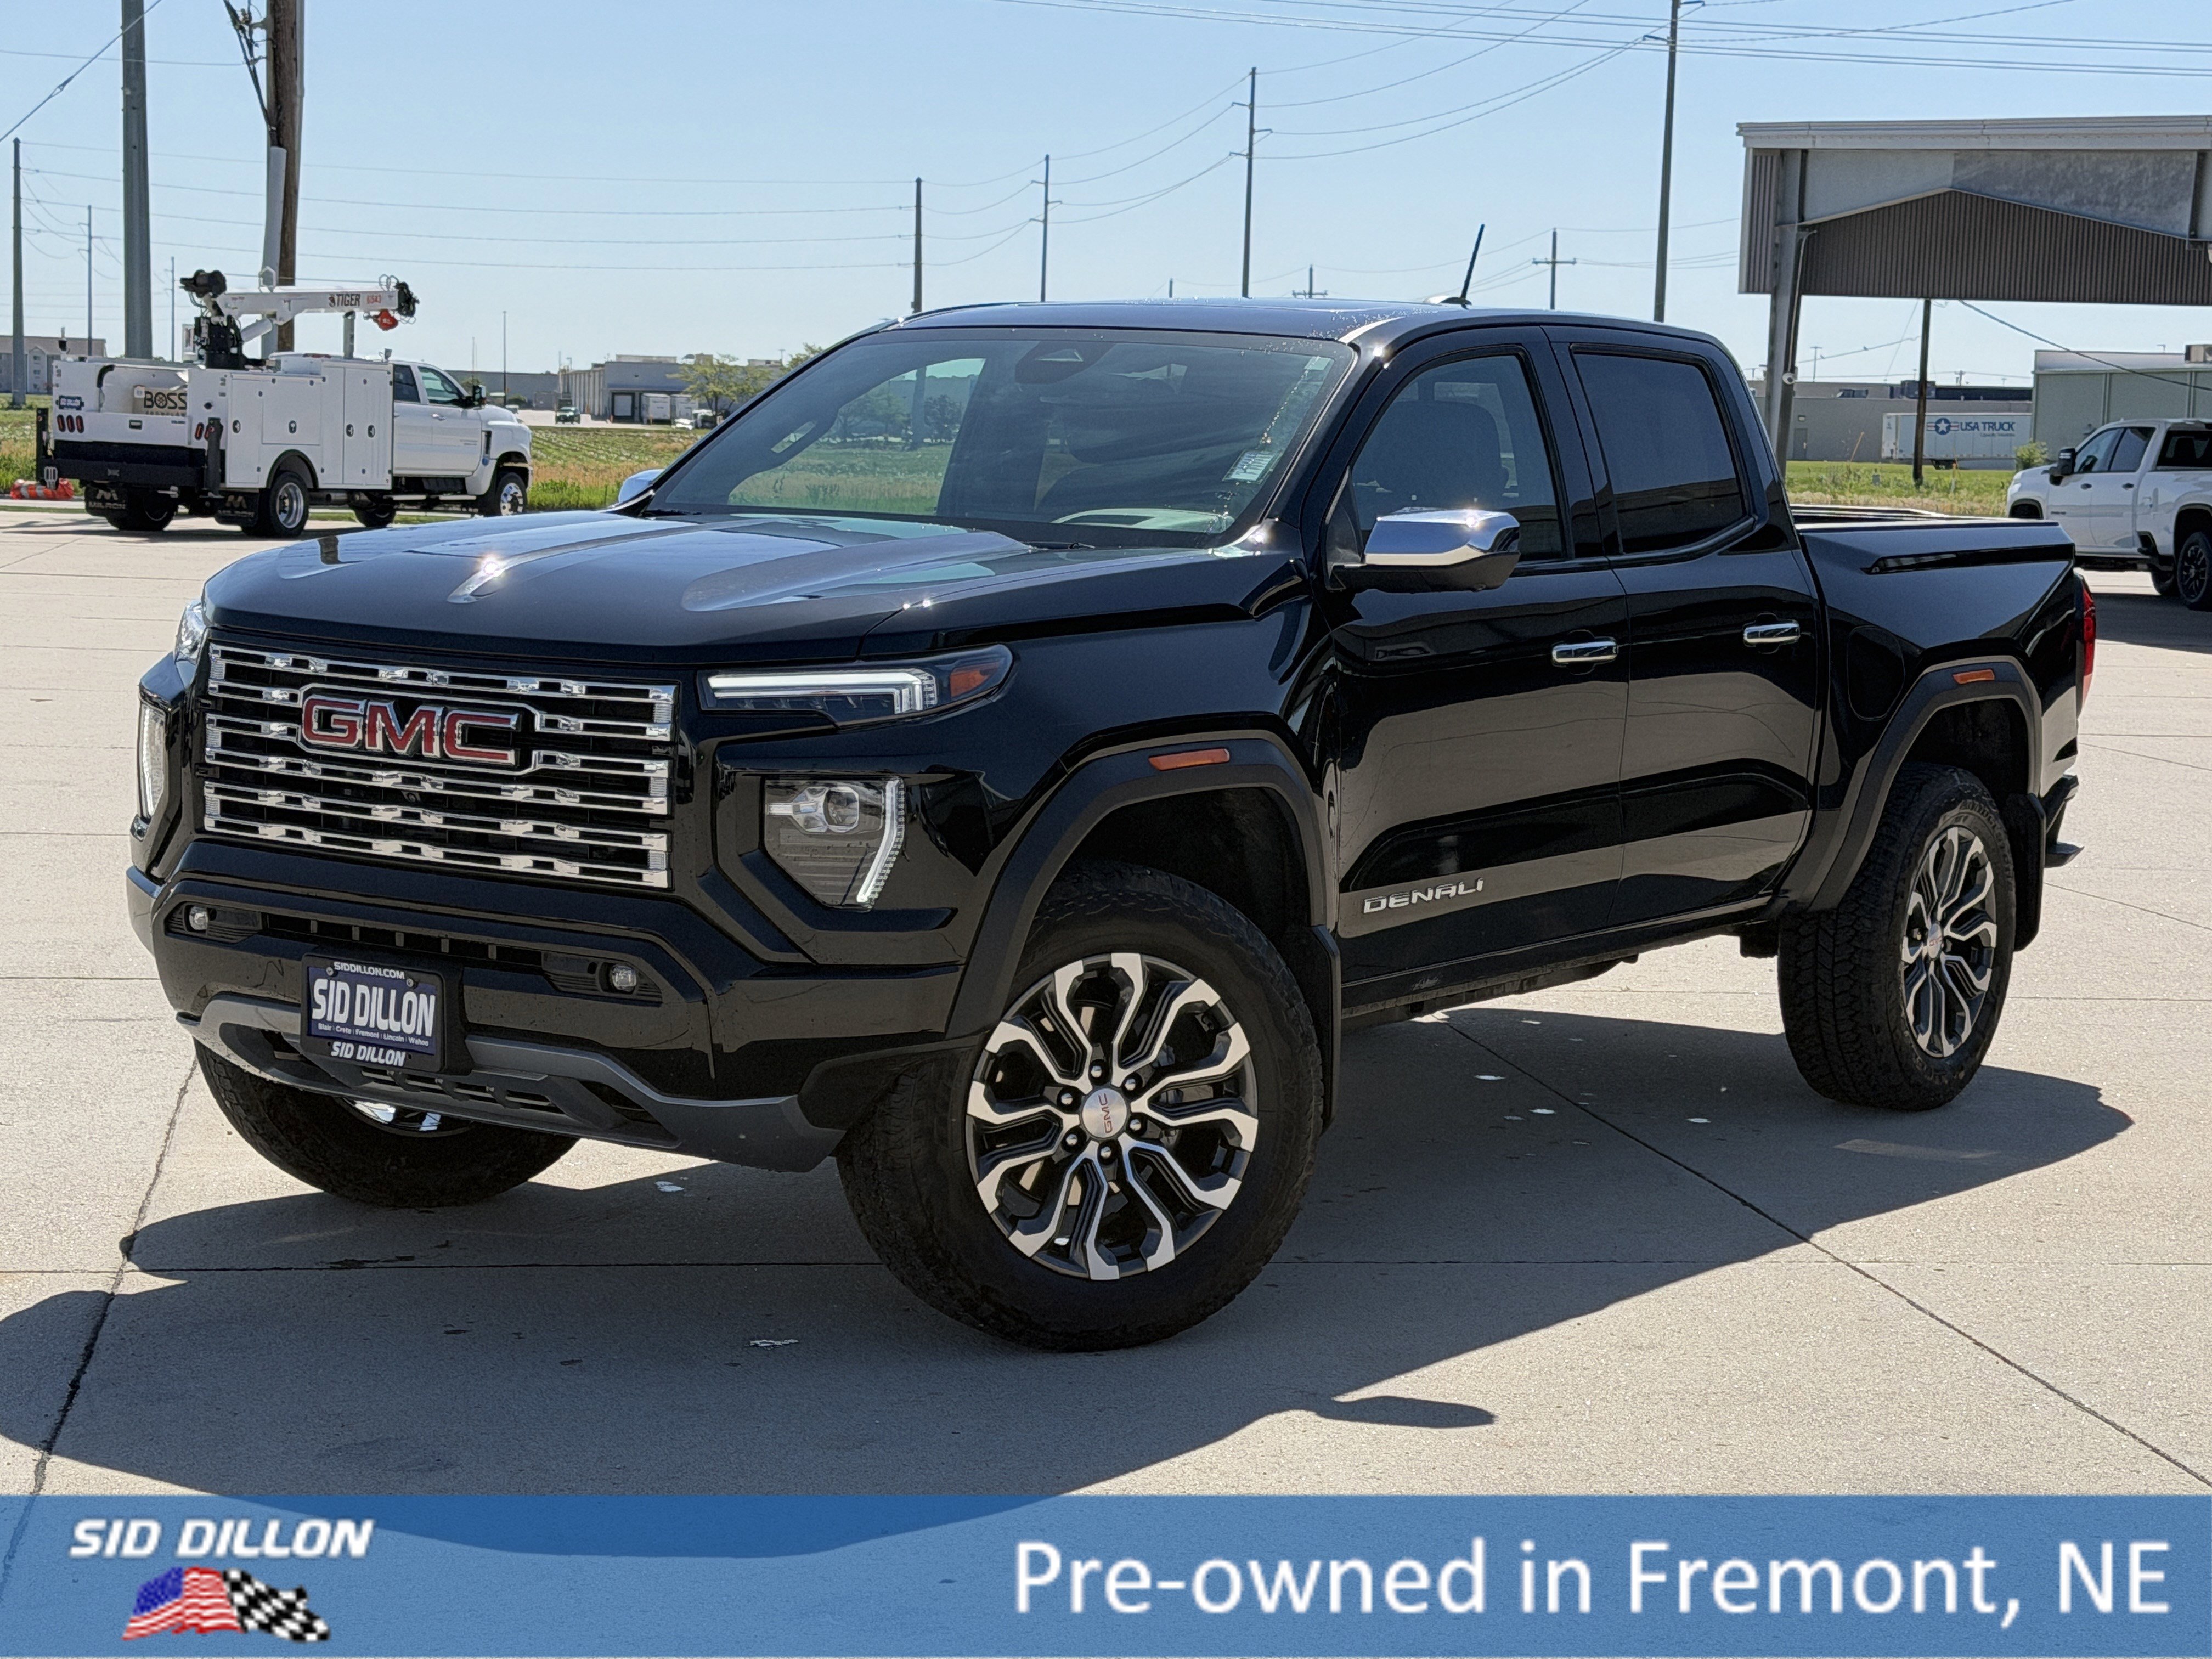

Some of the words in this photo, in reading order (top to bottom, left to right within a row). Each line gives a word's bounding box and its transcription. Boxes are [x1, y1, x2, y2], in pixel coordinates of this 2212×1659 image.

[336, 294, 360, 307] TIGER
[144, 391, 187, 410] BOSS
[1960, 422, 1980, 431] USA
[1982, 421, 2016, 431] TRUCK
[302, 694, 520, 766] GMC
[1363, 878, 1483, 913] DENALI
[334, 961, 405, 979] SIDDILLON.COM
[312, 978, 350, 1024] SID
[354, 984, 436, 1037] DILLON
[318, 1023, 332, 1031] Blair
[331, 1041, 354, 1058] SID
[357, 1045, 406, 1066] DILLON
[1098, 1093, 1113, 1134] GMC
